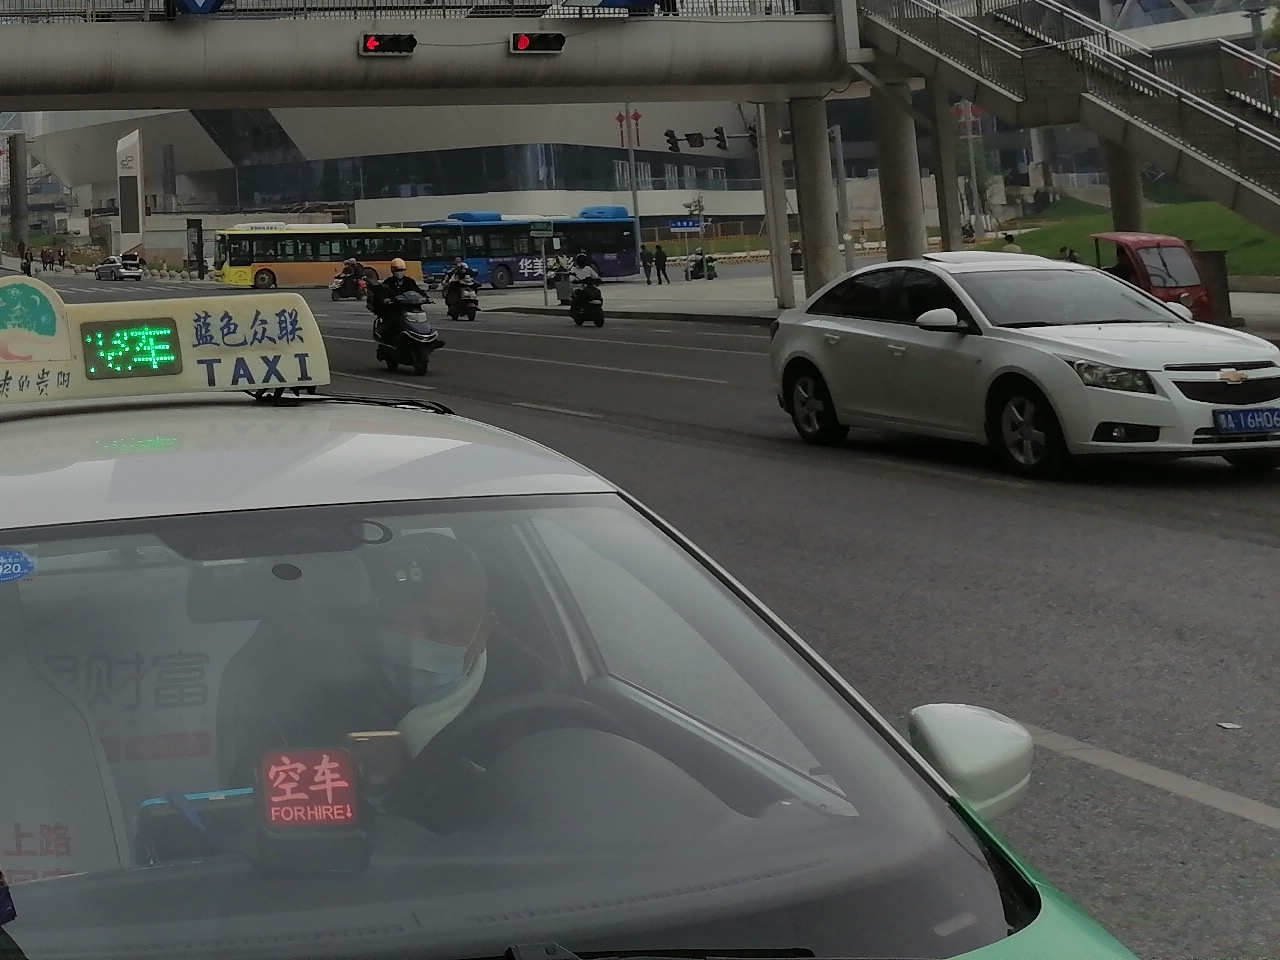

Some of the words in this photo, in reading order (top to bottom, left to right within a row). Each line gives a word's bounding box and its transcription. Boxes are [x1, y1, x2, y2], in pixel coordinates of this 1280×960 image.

[192, 309, 305, 348] 蓝色众联
[197, 353, 313, 387] TAXI
[268, 753, 349, 804] 空车
